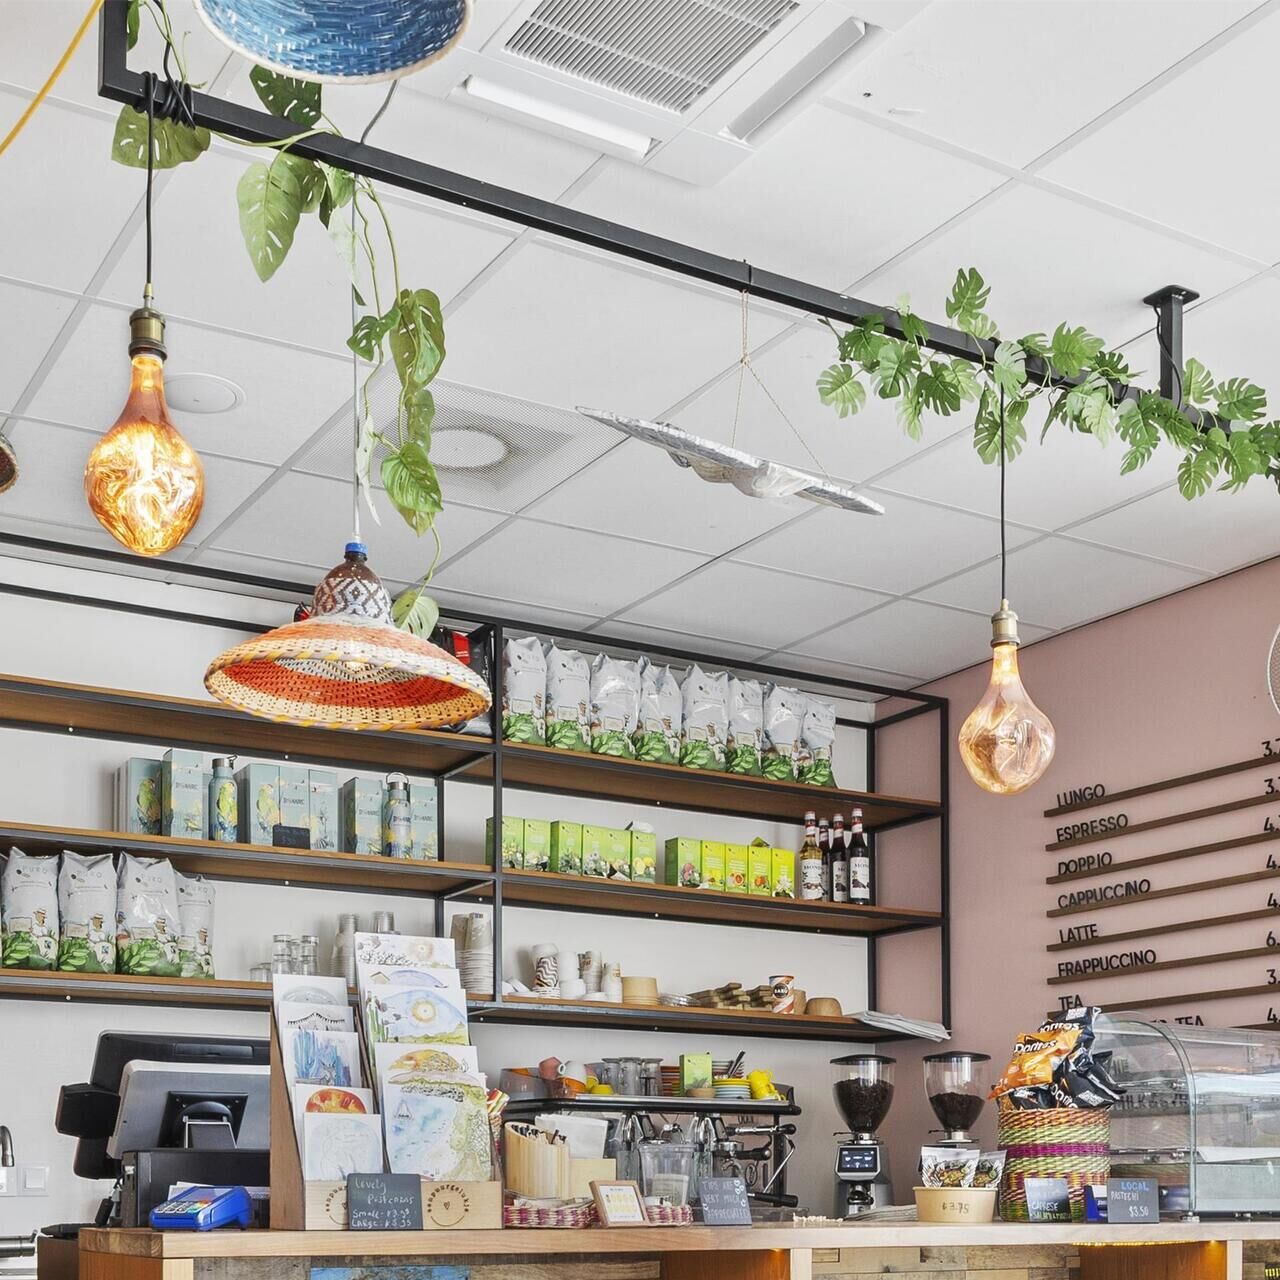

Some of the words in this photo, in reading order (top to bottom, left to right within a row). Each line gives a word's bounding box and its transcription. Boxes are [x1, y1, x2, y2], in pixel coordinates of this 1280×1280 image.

[1056, 783, 1105, 808] LUNGO
[1056, 813, 1129, 843] ESPRESSO
[1058, 852, 1113, 876] DOPPIO
[1058, 878, 1151, 910] CAPPUCCINO
[1059, 924, 1099, 944] LATTE
[1058, 949, 1157, 977] FRAPPUCCINO
[1058, 994, 1083, 1012] TEA
[1015, 1039, 1057, 1053] Doritos
[1121, 1181, 1149, 1192] LOCAL
[1128, 1205, 1150, 1218] $3.50
